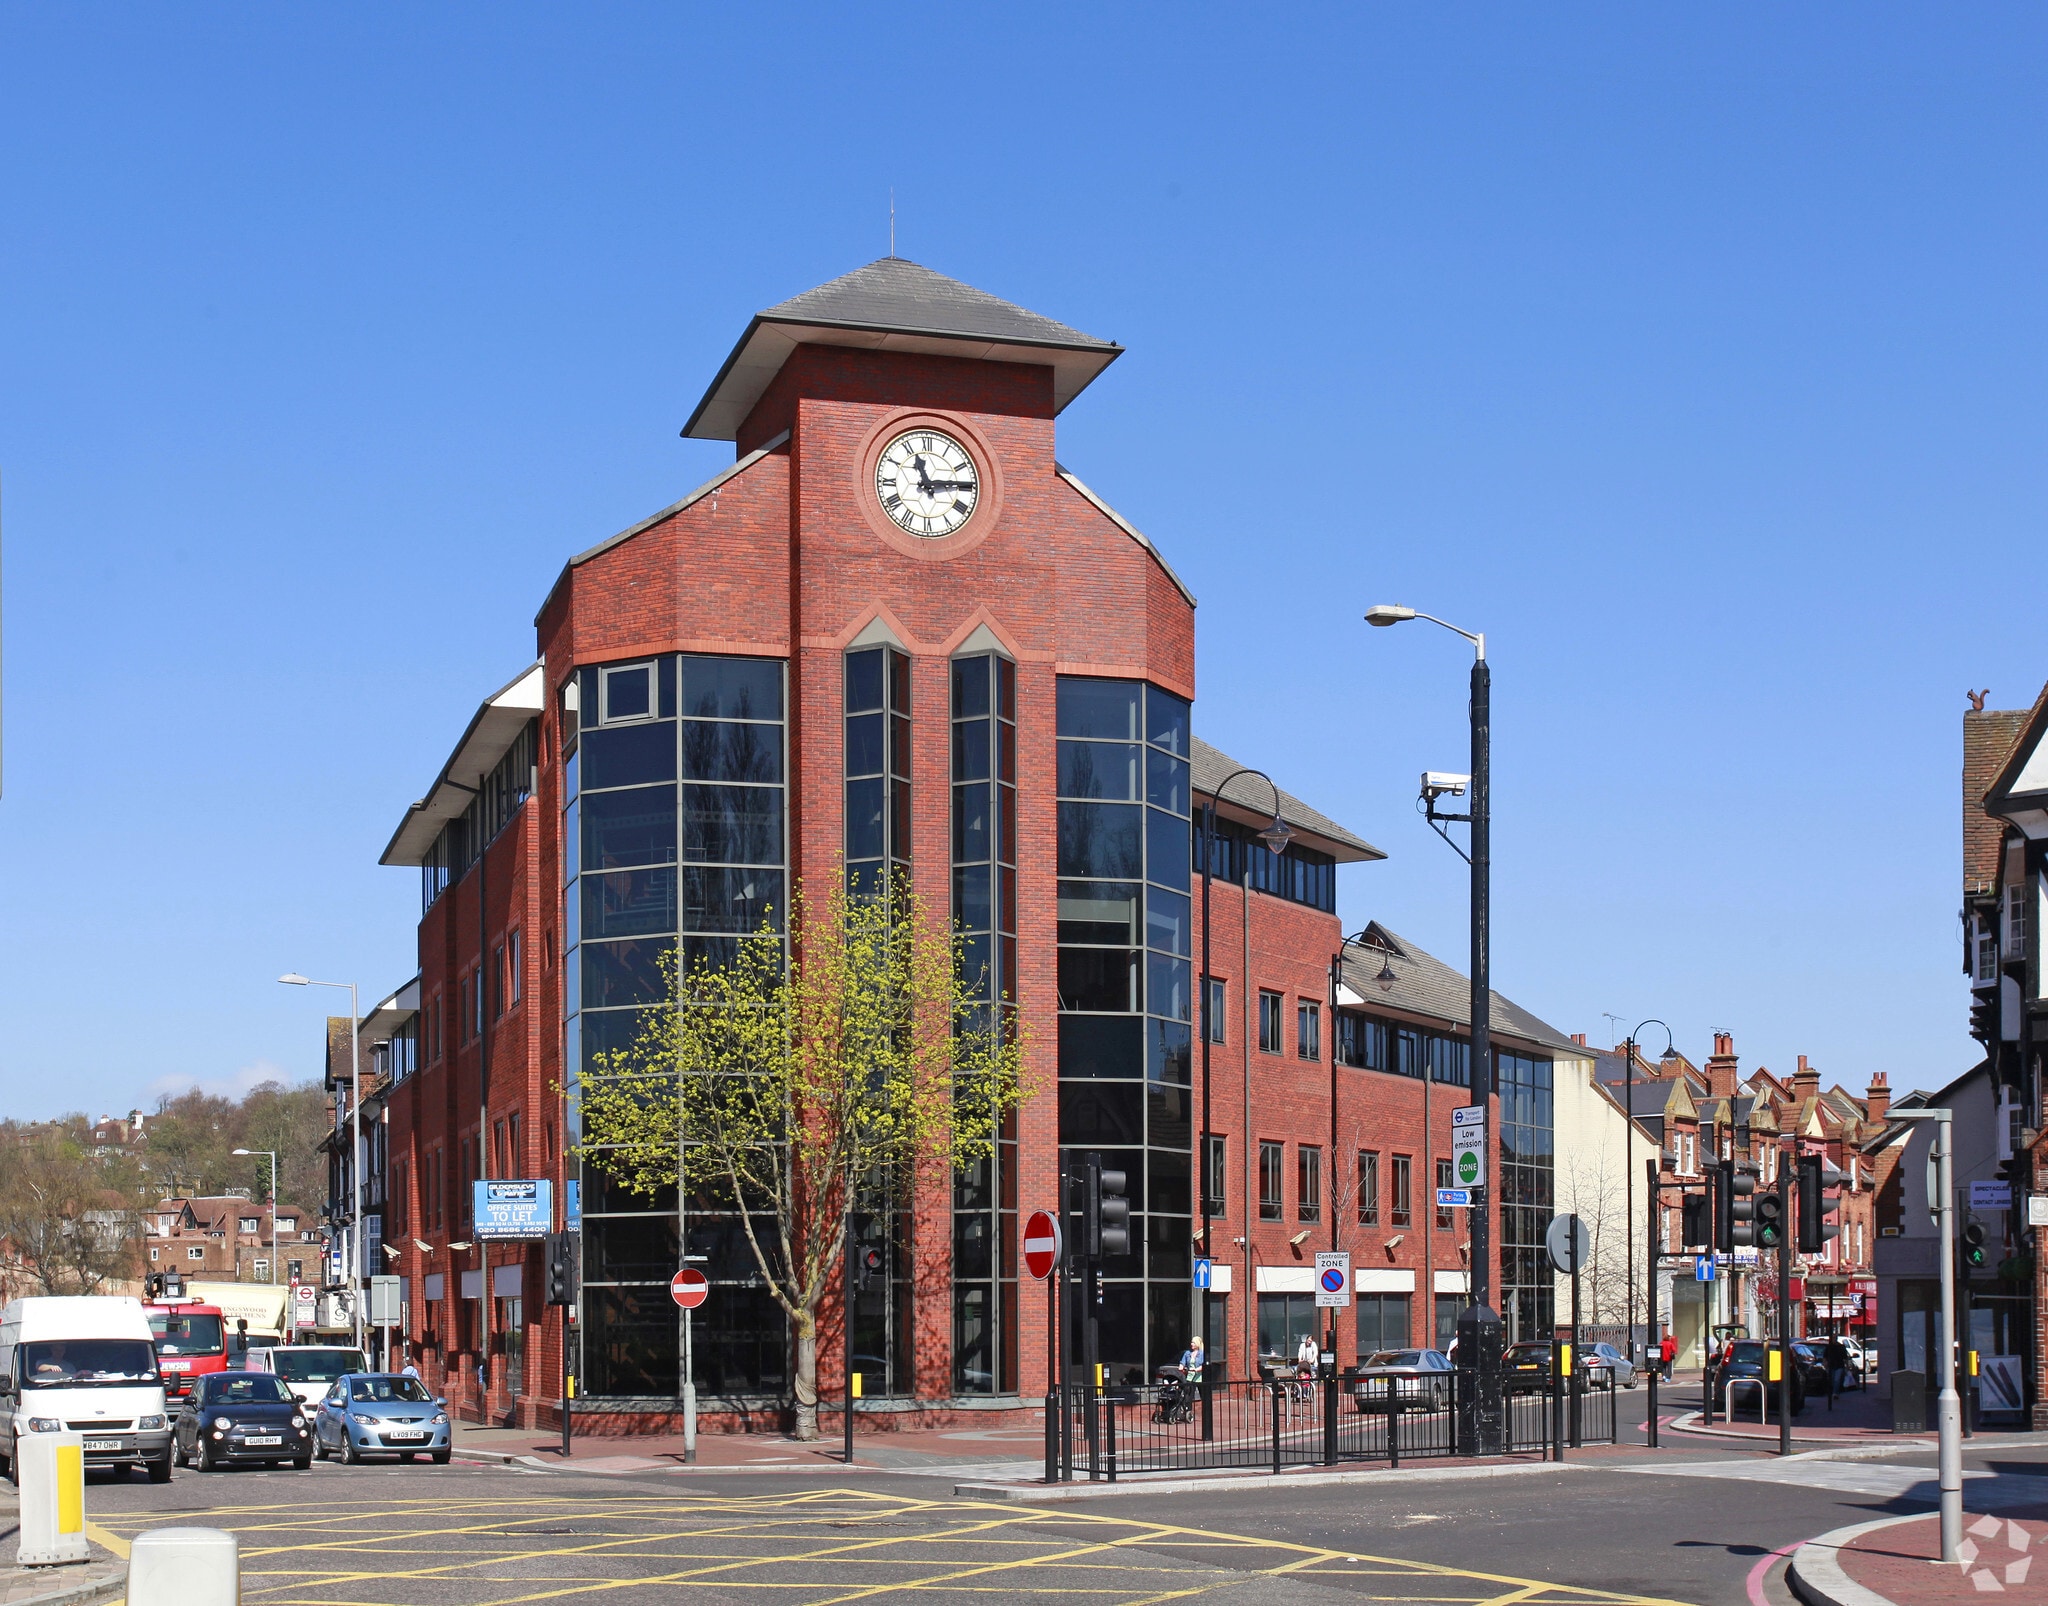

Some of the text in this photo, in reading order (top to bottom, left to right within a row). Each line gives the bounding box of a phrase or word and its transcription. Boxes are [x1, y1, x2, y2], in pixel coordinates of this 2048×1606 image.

[901, 439, 914, 456] XI
[921, 437, 933, 452] XII
[942, 445, 950, 458] I
[887, 456, 901, 469] X
[954, 462, 967, 472] II
[882, 477, 896, 487] IX
[901, 509, 915, 527] VII
[942, 514, 952, 528] V
[923, 517, 932, 532] VI
[1462, 1130, 1475, 1138] Low
[1454, 1140, 1482, 1149] emission
[1459, 1163, 1477, 1172] ZONE
[487, 1203, 538, 1212] OFFICE SUITES
[492, 1211, 533, 1222] TO LET
[160, 1361, 191, 1370] JEWSON
[103, 1441, 119, 1449] OHR
